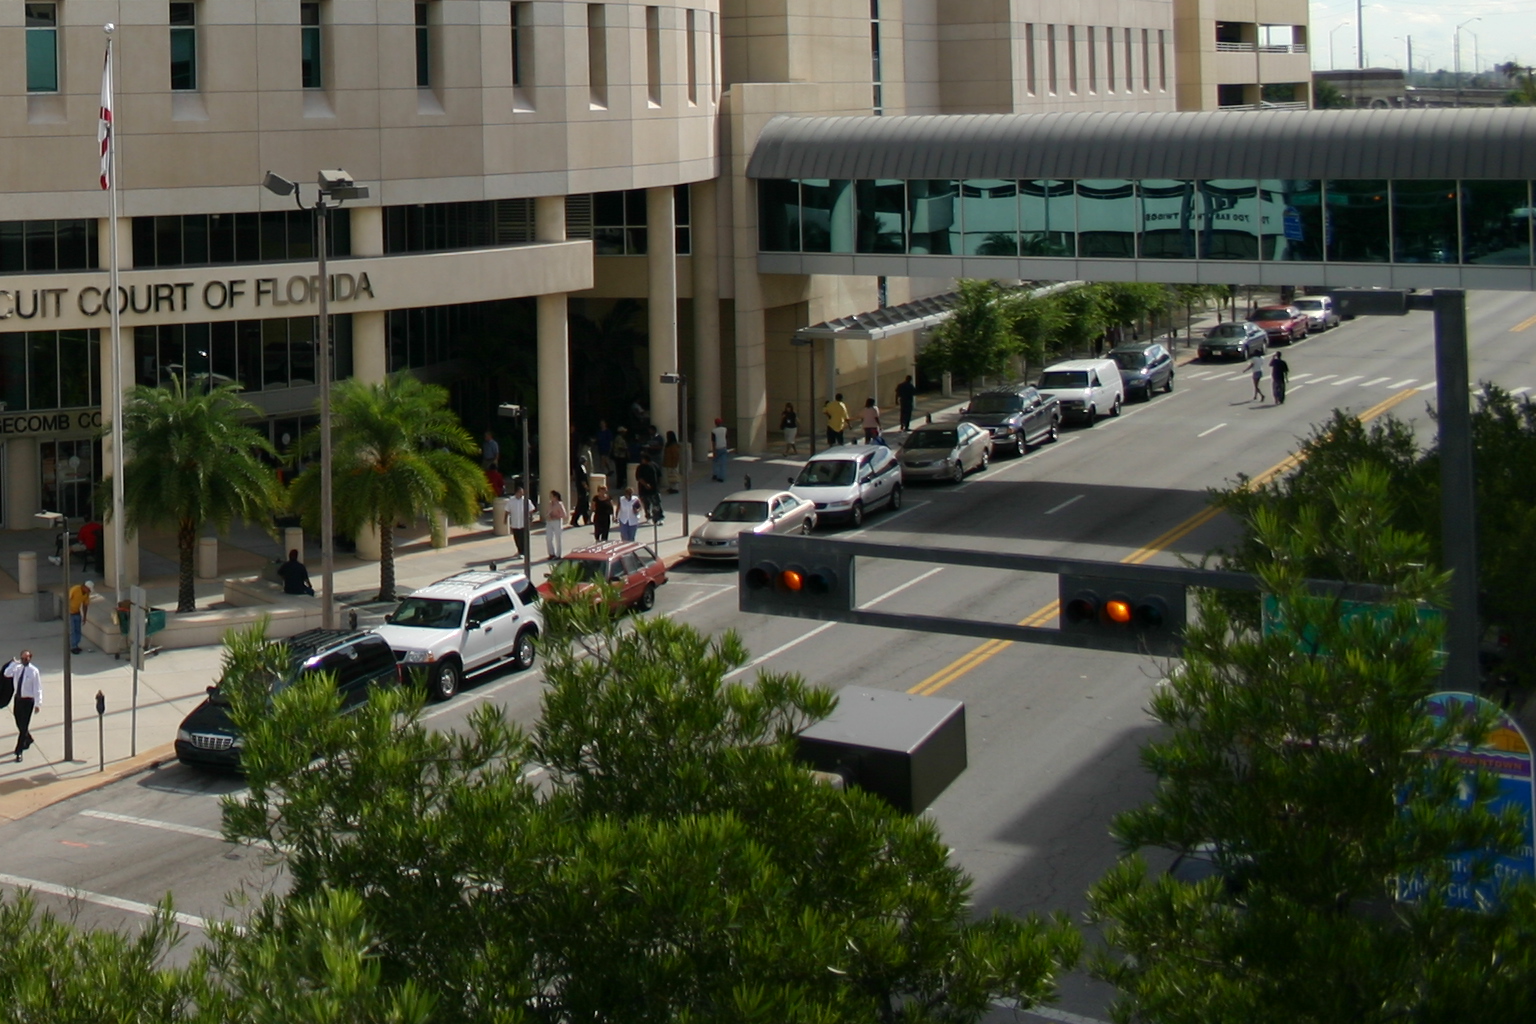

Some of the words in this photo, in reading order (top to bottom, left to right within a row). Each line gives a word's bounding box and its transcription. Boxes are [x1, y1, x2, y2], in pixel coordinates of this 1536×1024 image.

[77, 281, 195, 317] COURT
[202, 279, 246, 310] OF
[255, 271, 375, 307] FLORIDA
[1456, 756, 1523, 771] OWNTOWN
[1447, 882, 1470, 899] Cit
